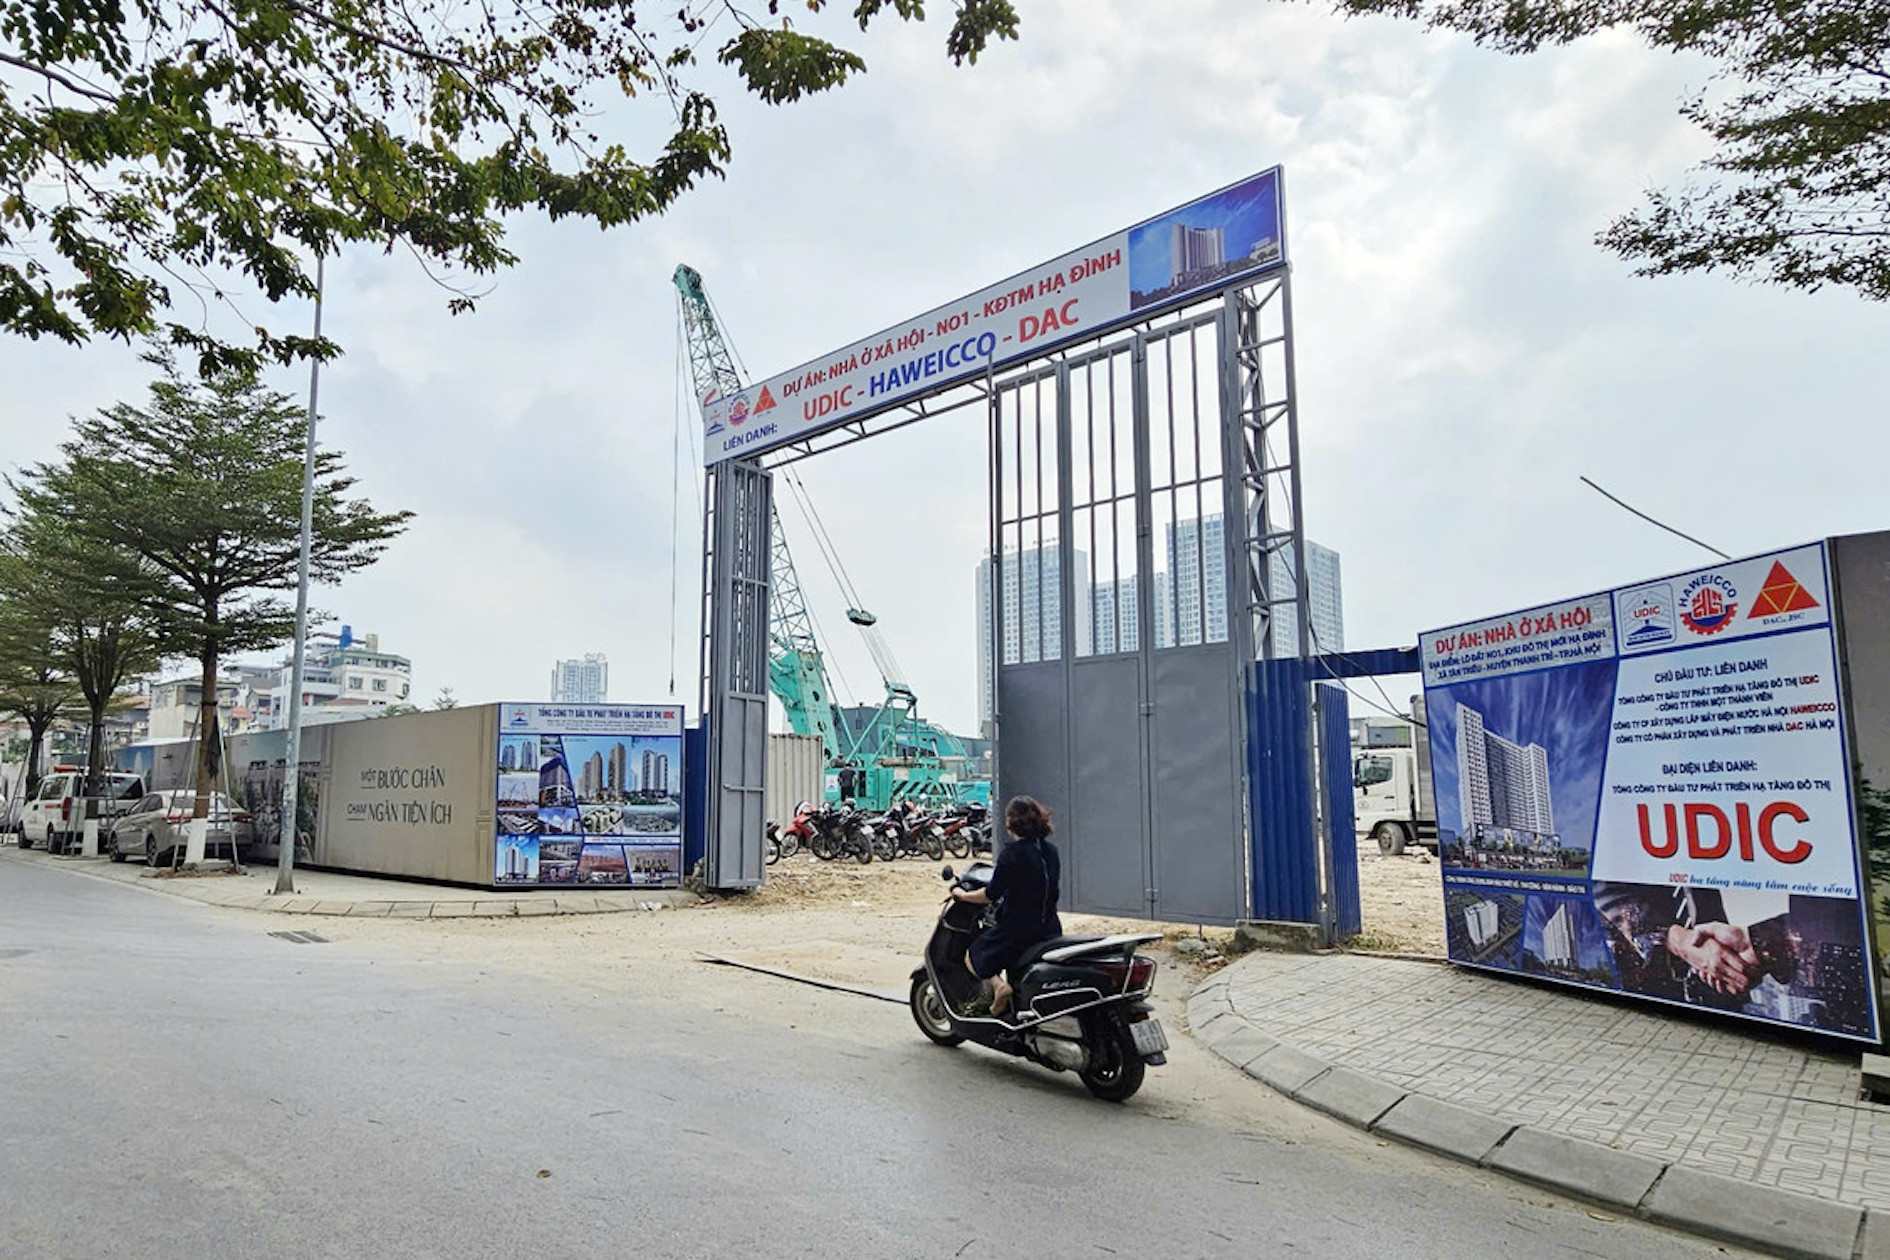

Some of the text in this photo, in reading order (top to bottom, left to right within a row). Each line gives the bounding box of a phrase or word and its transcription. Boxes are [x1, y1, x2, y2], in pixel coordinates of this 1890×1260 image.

[783, 375, 802, 397] DỰ
[804, 368, 826, 389] ÁN:
[829, 352, 857, 379] NHÀ
[861, 347, 873, 366] Ở
[874, 339, 894, 361] XÃ
[897, 328, 925, 351] HỘI
[983, 284, 1034, 318] KĐTM
[1038, 273, 1066, 296] HẠ
[1069, 248, 1121, 284] ĐÌNH
[723, 433, 744, 451] LIÊN
[746, 422, 778, 444] DANH:
[804, 385, 853, 421] UDIC
[870, 331, 996, 397] HAWEICCO
[1019, 298, 1079, 343] DAC
[1679, 574, 1738, 607] HAWEICCO
[1633, 605, 1661, 619] UDIC
[1436, 607, 1591, 654] DỰ ÁN: NHÀ Ở XÃ HỘI
[1655, 658, 1768, 683] CHỦ ĐẦU TƯ: LIÊN DANH
[1799, 675, 1819, 685] UDIC
[1632, 720, 1639, 728] TY
[1761, 706, 1772, 716] HÀ
[1790, 702, 1837, 715] HAWEICCO
[1680, 701, 1689, 709] TY
[1634, 734, 1642, 742] TY
[1786, 721, 1804, 731] DAC
[1806, 719, 1818, 729] HÀ
[1820, 718, 1835, 730] NỘI
[378, 766, 408, 789] BƯỚC
[411, 765, 445, 788] CHÂN
[1662, 760, 1758, 777] ĐẠI DIỆN LIÊN DANH:
[1634, 783, 1655, 793] CÔNG
[1656, 784, 1666, 792] TY
[1687, 783, 1698, 792] TƯ
[1700, 781, 1722, 792] PHÁT
[1753, 782, 1766, 792] HẠ
[1768, 779, 1795, 790] TẦNG
[1797, 778, 1812, 790] ĐÔ
[1814, 780, 1831, 791] THỊ
[368, 800, 400, 822] NGÀN
[402, 800, 428, 825] TIỆN
[430, 800, 451, 824] ÍCH
[1637, 801, 1813, 864] UDIC
[1669, 873, 1688, 883] UDIC
